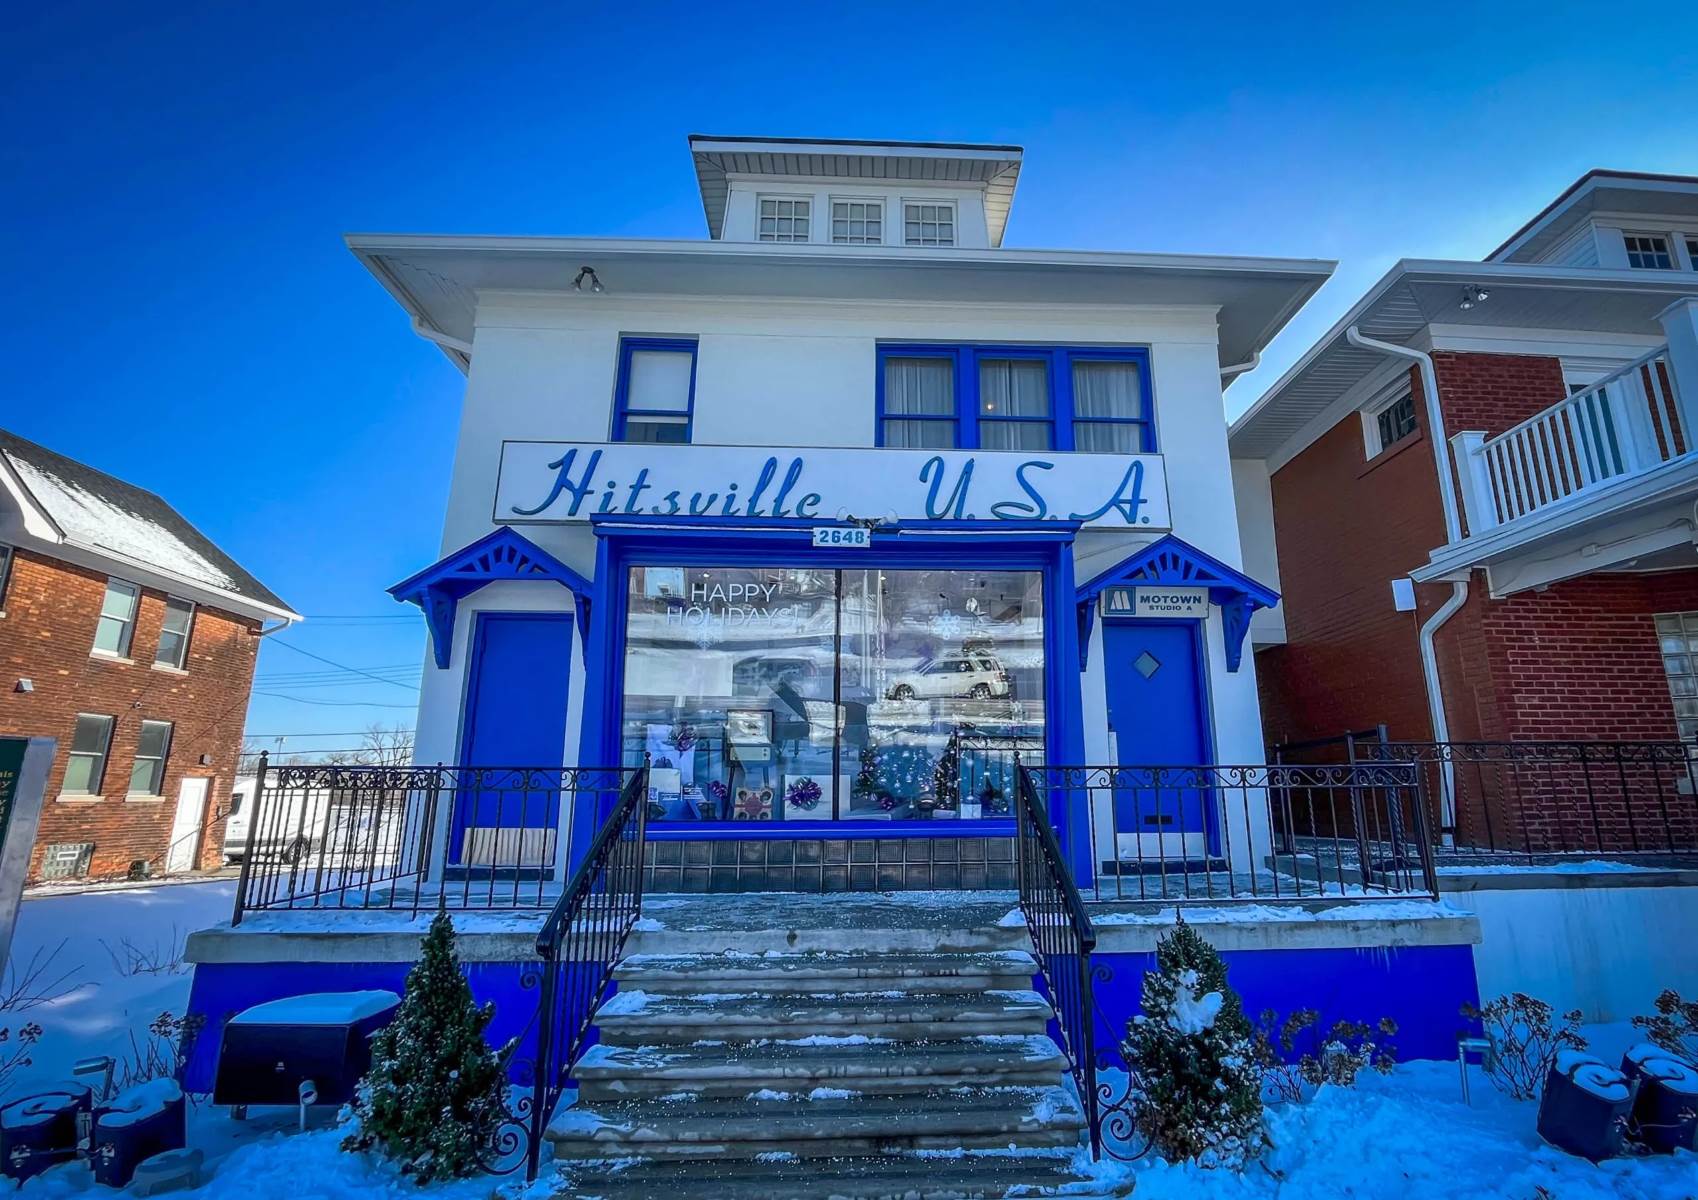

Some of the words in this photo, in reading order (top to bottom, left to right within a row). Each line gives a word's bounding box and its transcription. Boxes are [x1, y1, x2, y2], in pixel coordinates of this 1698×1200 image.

[512, 448, 821, 517] Hitsville
[819, 530, 865, 544] 2648
[691, 583, 777, 602] HAPPY
[1140, 595, 1202, 604] MOTOWN
